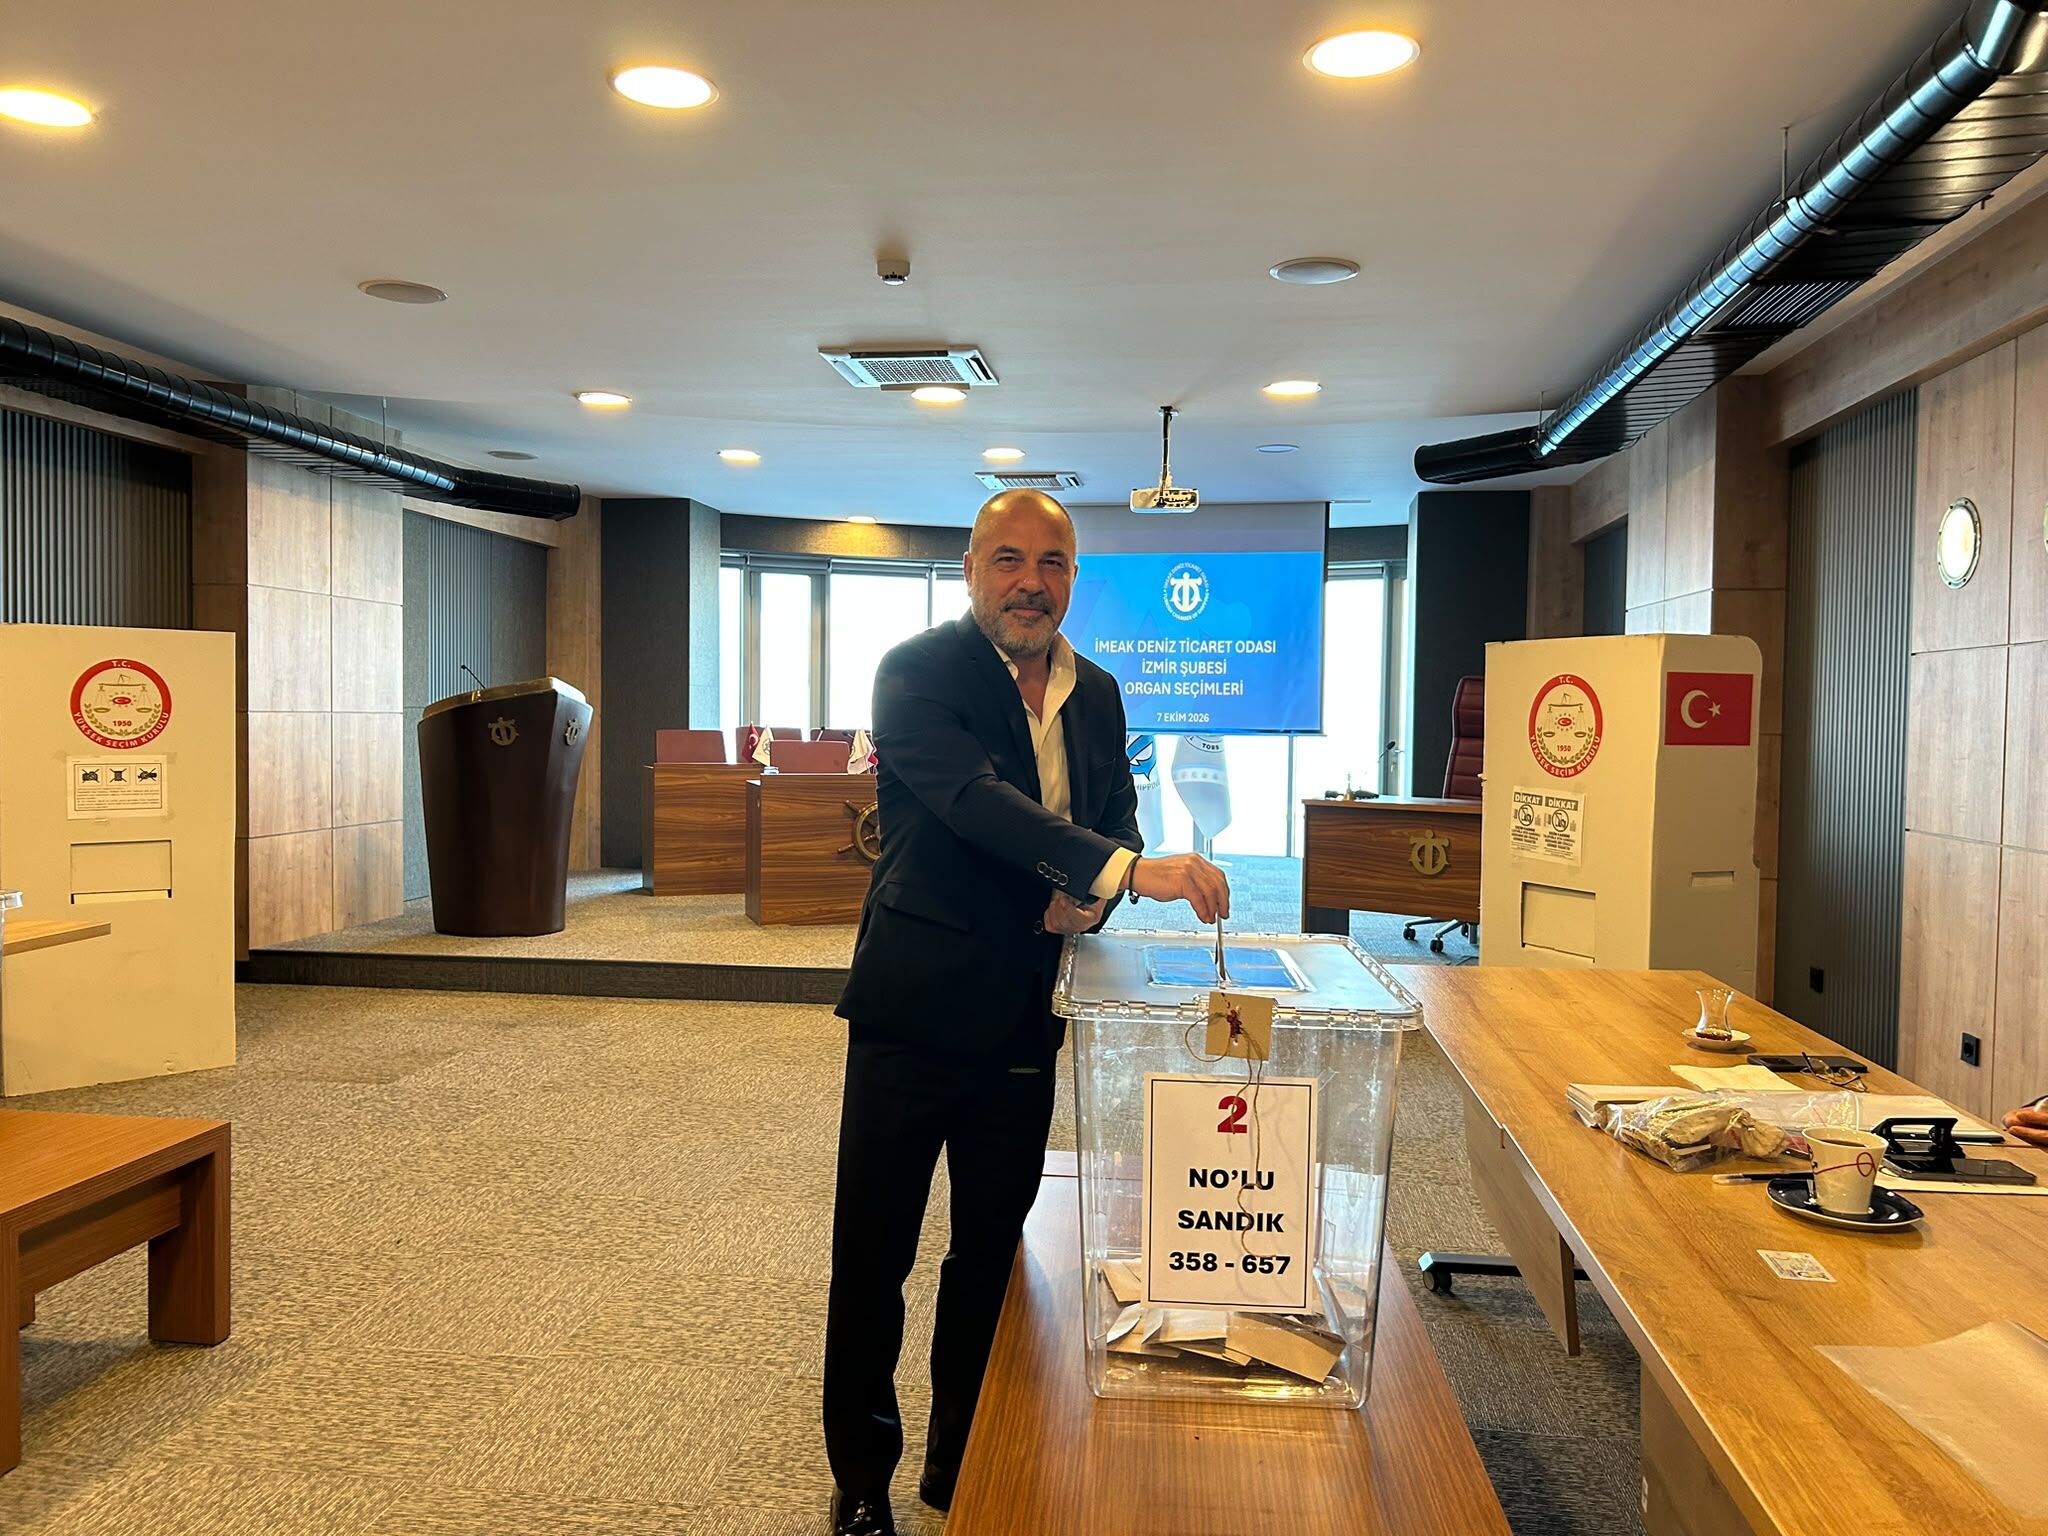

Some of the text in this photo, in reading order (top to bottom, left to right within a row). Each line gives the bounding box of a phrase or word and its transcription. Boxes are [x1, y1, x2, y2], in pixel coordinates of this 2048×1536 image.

[1094, 638, 1276, 654] İMEAK DENİZ TİCARET ODASI
[1142, 658, 1227, 677] İZMİR ŞUBESİ
[1125, 680, 1244, 698] ORGAN SEÇİMLERİ
[1156, 711, 1210, 722] 7 EKİM 2026
[106, 739, 138, 748] SEÇİM
[140, 712, 169, 742] KURULU
[1551, 767, 1574, 776] SEÇİM
[1577, 736, 1600, 771] KURULU
[1548, 797, 1576, 810] DİKKAT
[1217, 1096, 1248, 1133] 2
[1189, 1168, 1274, 1190] NO’LU
[1178, 1210, 1284, 1232] SANDIK
[1169, 1252, 1217, 1271] 358
[1242, 1254, 1291, 1274] 657
